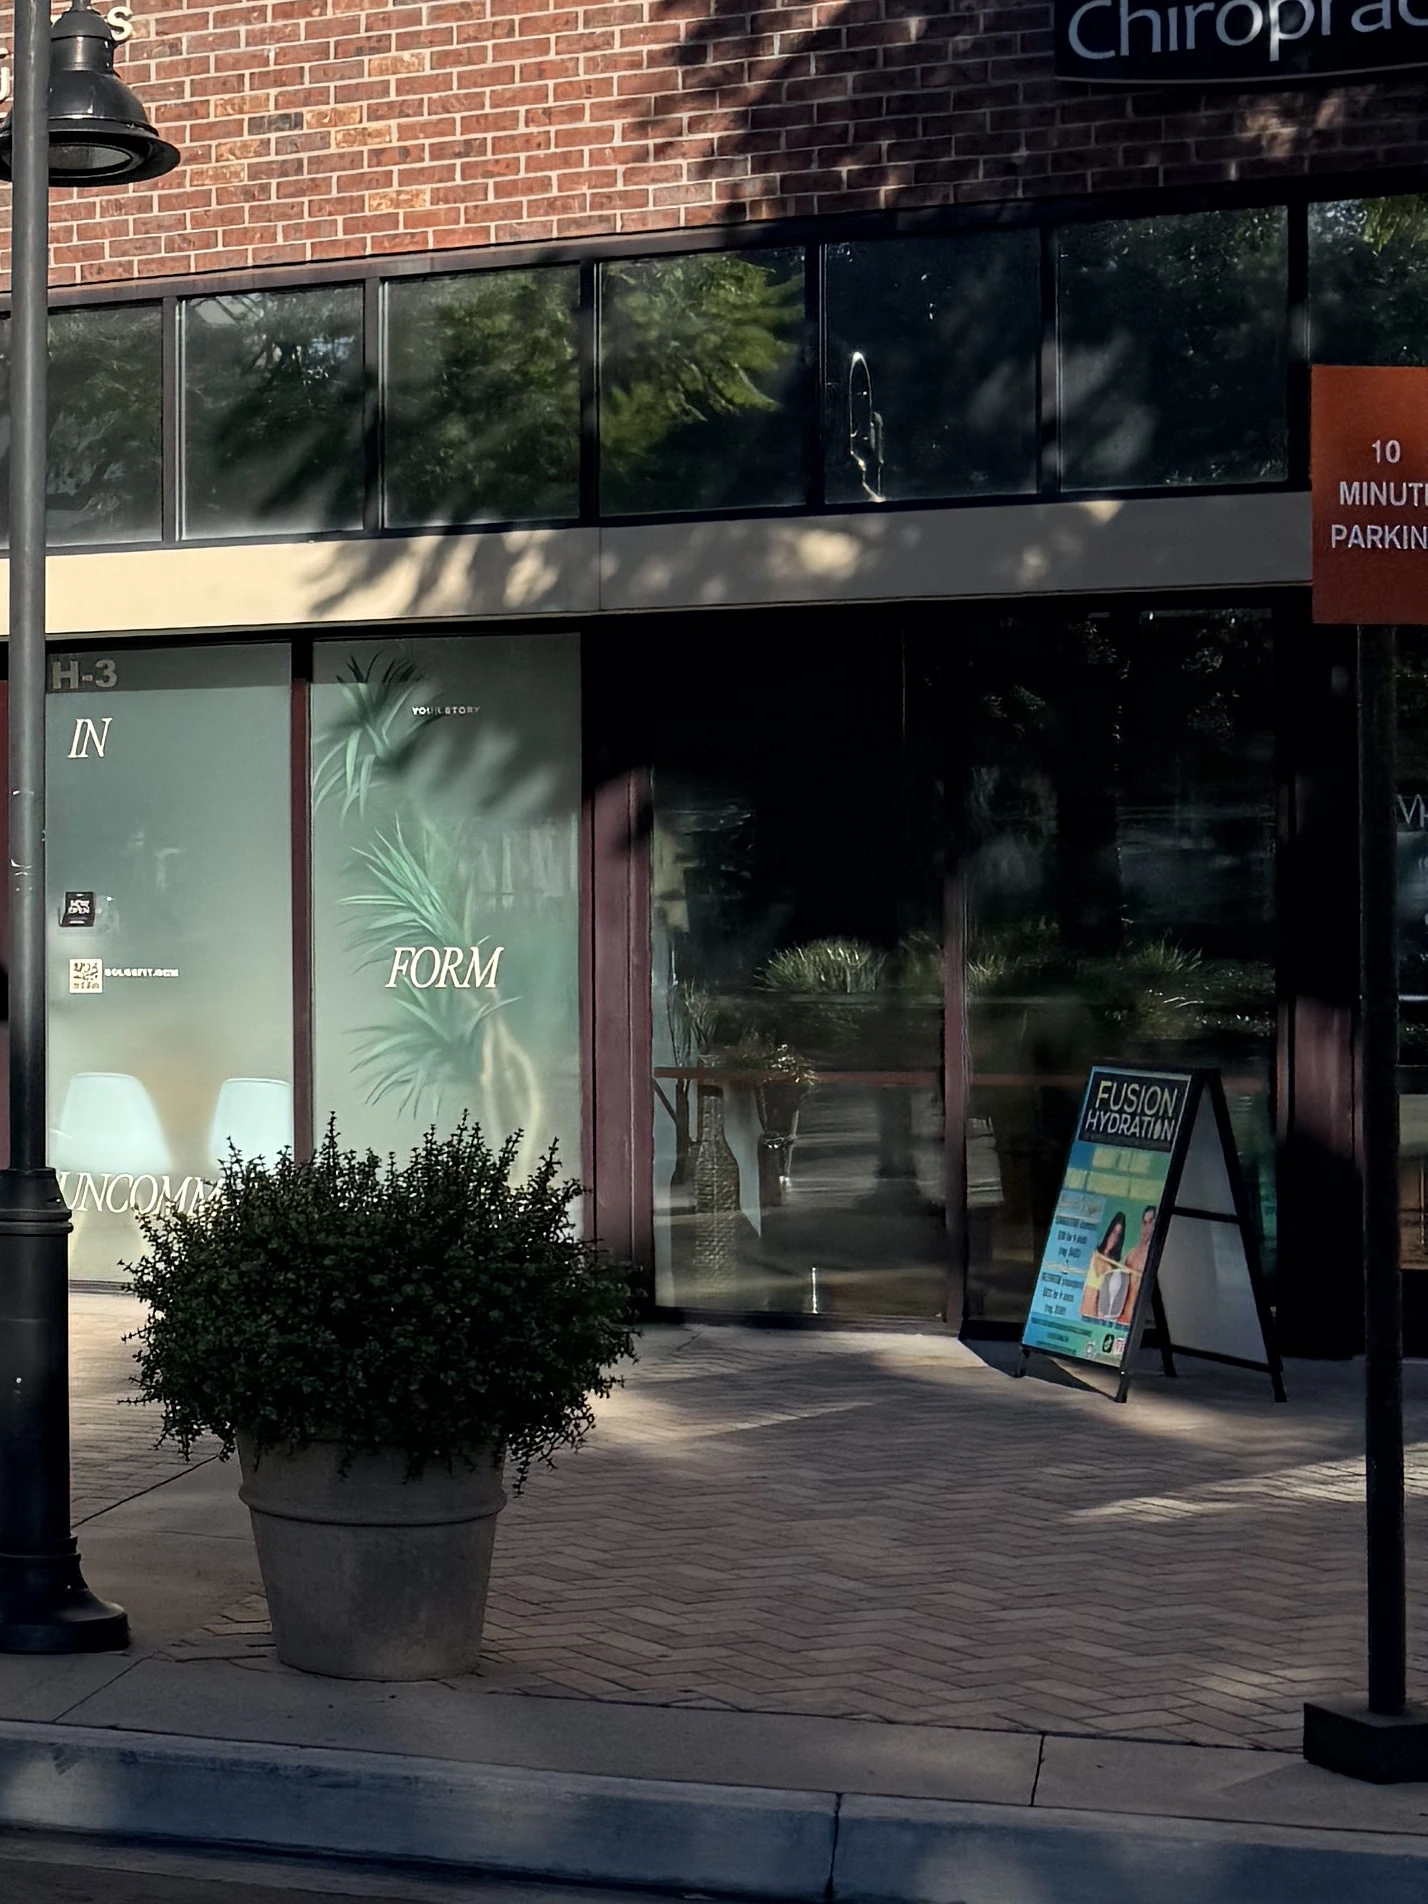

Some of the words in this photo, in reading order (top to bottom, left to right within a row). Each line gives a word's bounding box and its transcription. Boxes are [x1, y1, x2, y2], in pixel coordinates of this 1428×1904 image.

[1371, 439, 1401, 464] 10
[1331, 524, 1428, 549] PARKIN
[52, 659, 118, 689] H-3
[67, 717, 113, 758] IN
[384, 946, 505, 989] FORM
[1095, 1080, 1178, 1118] FUSION
[1084, 1109, 1175, 1142] HYDRATION
[58, 1170, 226, 1217] UNCOMM
